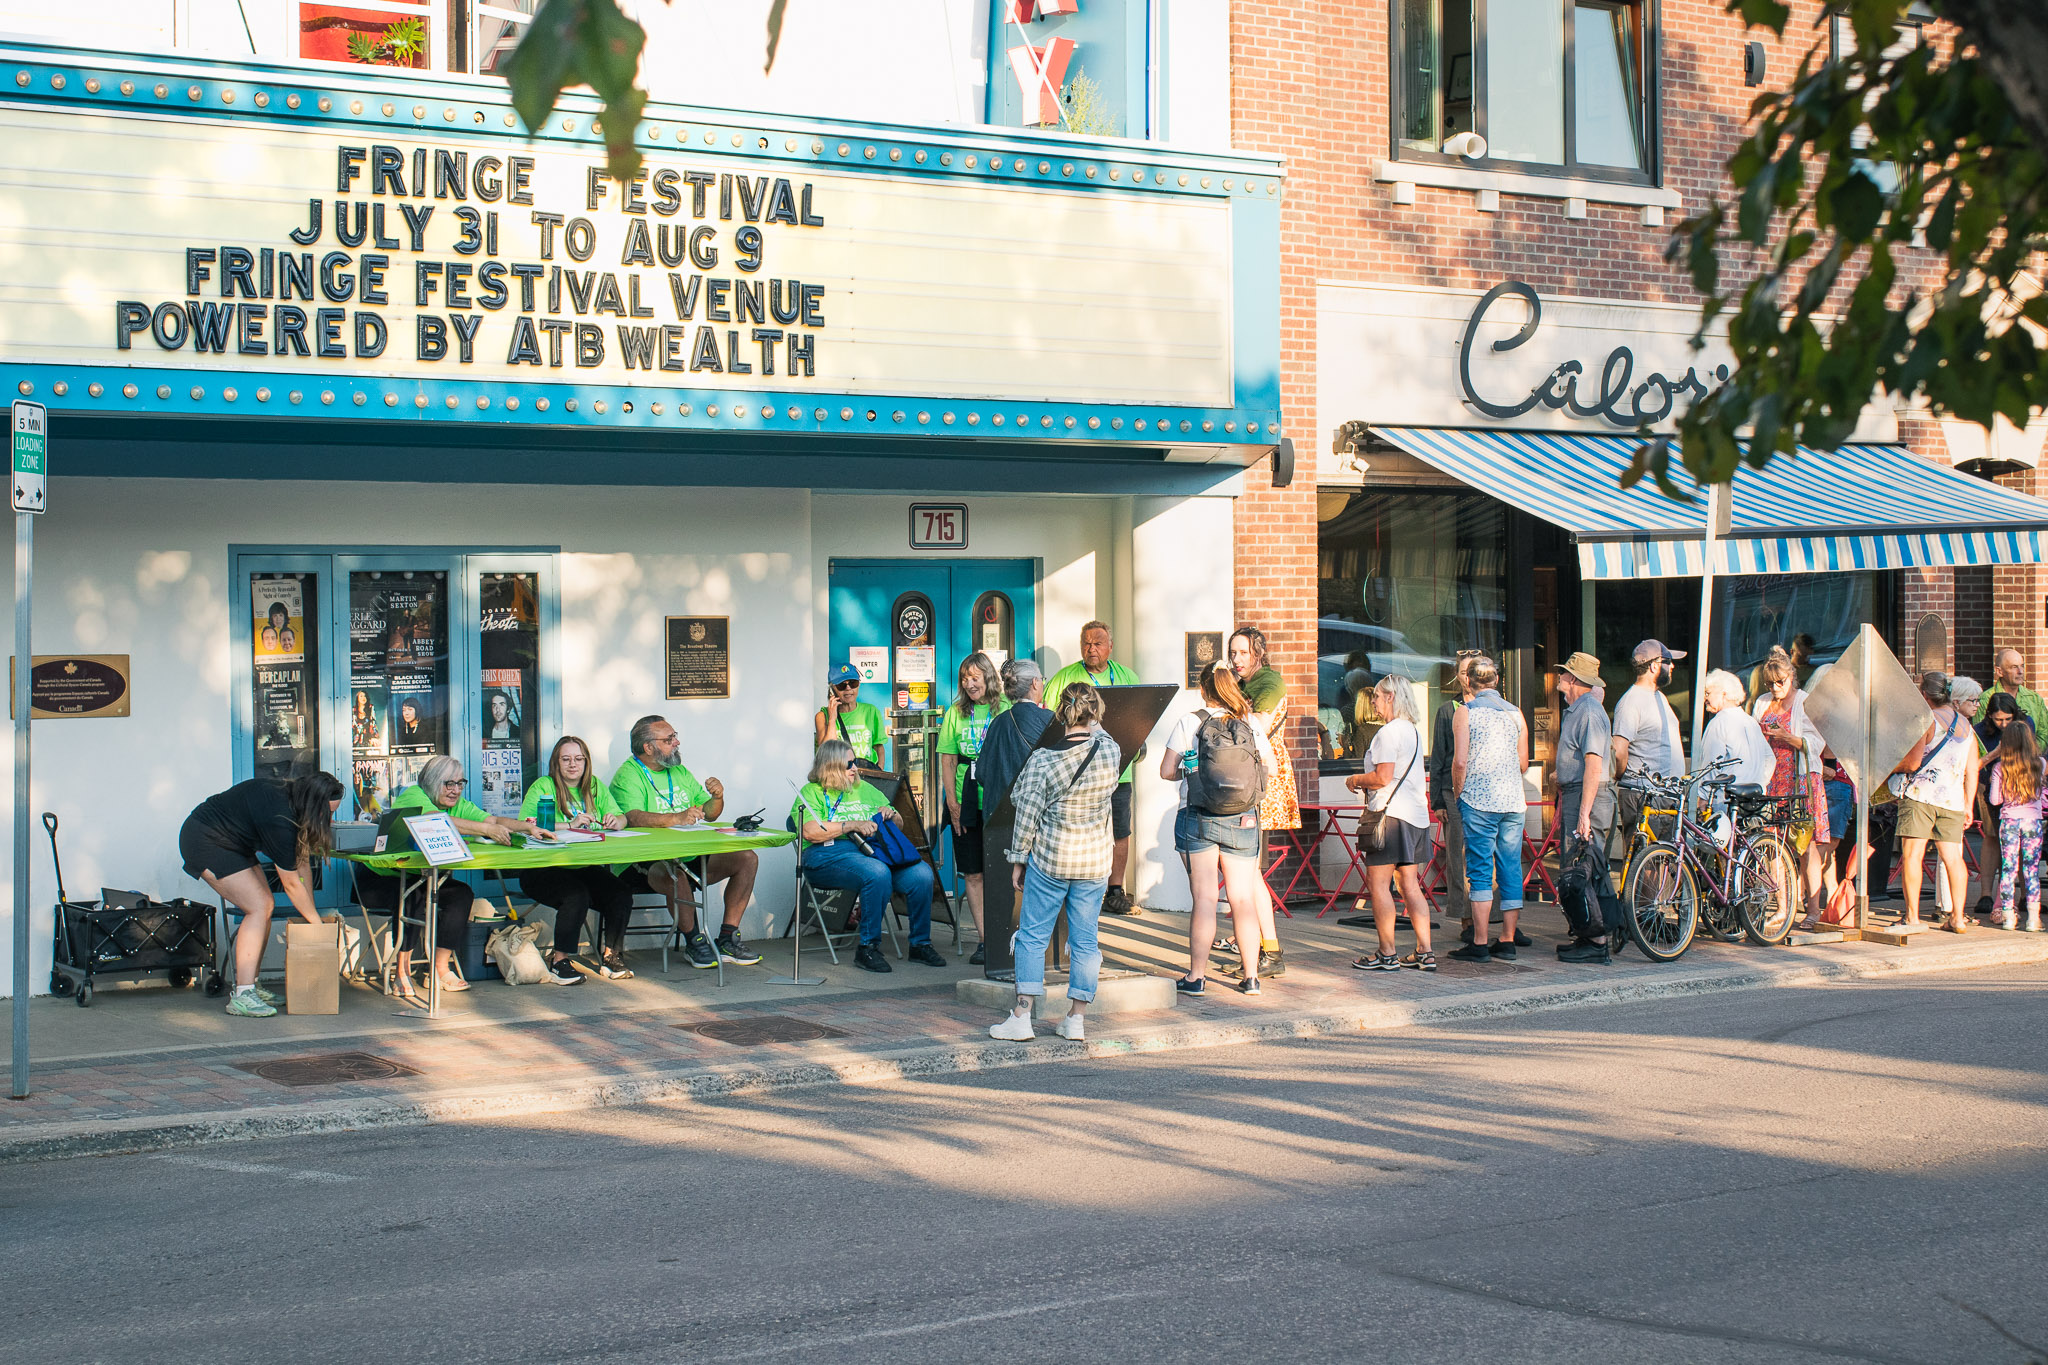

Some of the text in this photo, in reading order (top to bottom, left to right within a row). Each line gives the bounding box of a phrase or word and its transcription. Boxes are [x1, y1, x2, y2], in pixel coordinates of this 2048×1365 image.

[337, 144, 825, 227] FRINGE FESTIVAL
[289, 199, 763, 272] JULY 31 TO AUG 9
[186, 246, 825, 327] FRINGE FESTIVAL VENUE
[116, 300, 816, 377] POWERED BY ATB WEALTH
[20, 418, 40, 431] 5 MIN
[16, 436, 42, 452] LOADING
[21, 454, 39, 470] ZONE
[922, 512, 955, 541] 715
[905, 611, 923, 619] ENTER
[259, 670, 301, 684] BEN CAPLAN
[498, 669, 520, 682] COHEN
[482, 751, 520, 766] IG SIS
[424, 835, 450, 843] TICKET
[428, 842, 454, 850] BUYER
